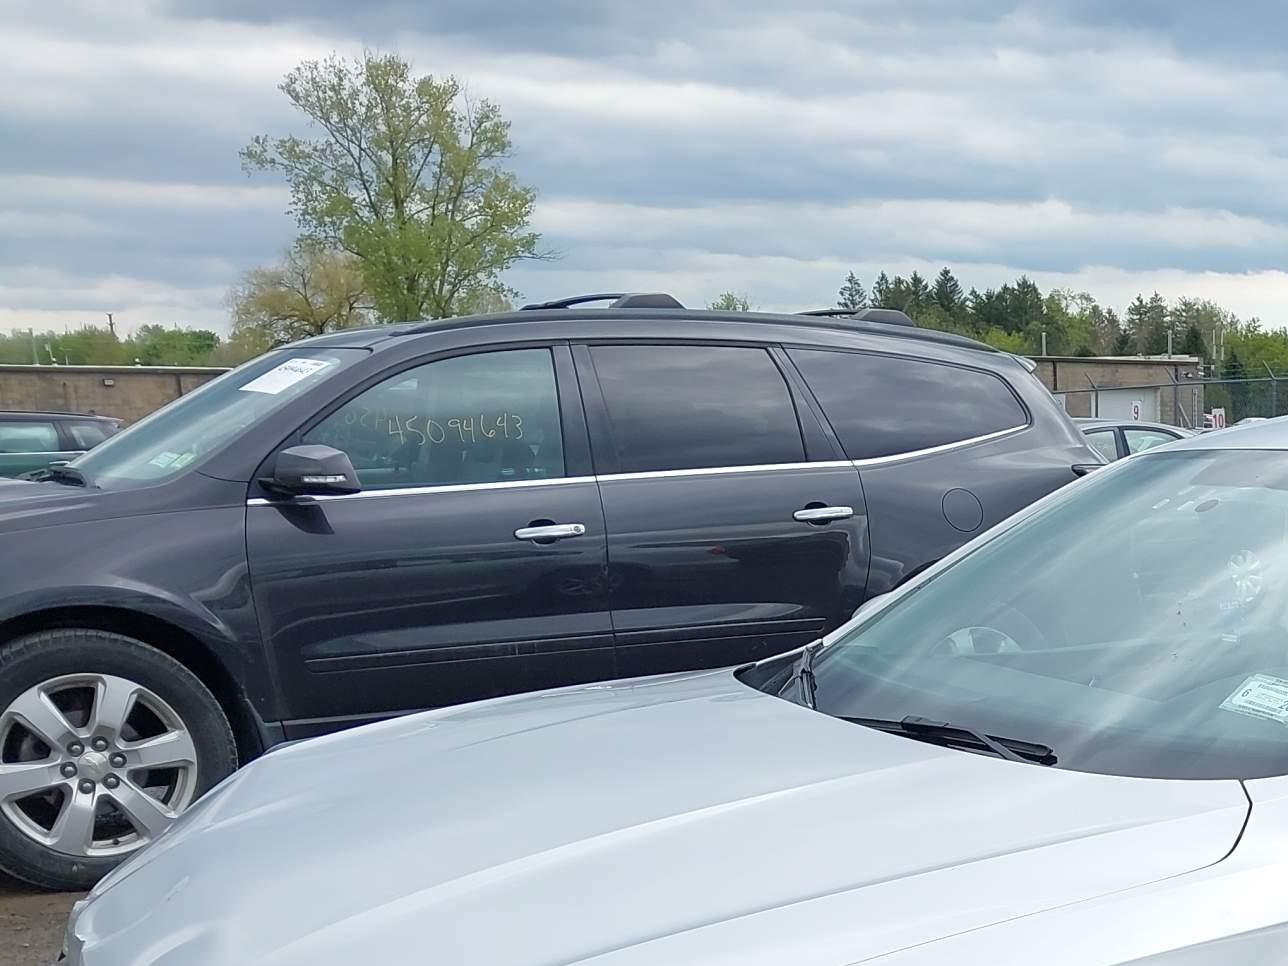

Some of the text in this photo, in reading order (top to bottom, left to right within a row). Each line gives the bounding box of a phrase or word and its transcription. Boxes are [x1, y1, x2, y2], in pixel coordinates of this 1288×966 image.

[1133, 404, 1139, 421] 9
[1212, 413, 1225, 429] 10
[388, 412, 524, 446] 45094643
